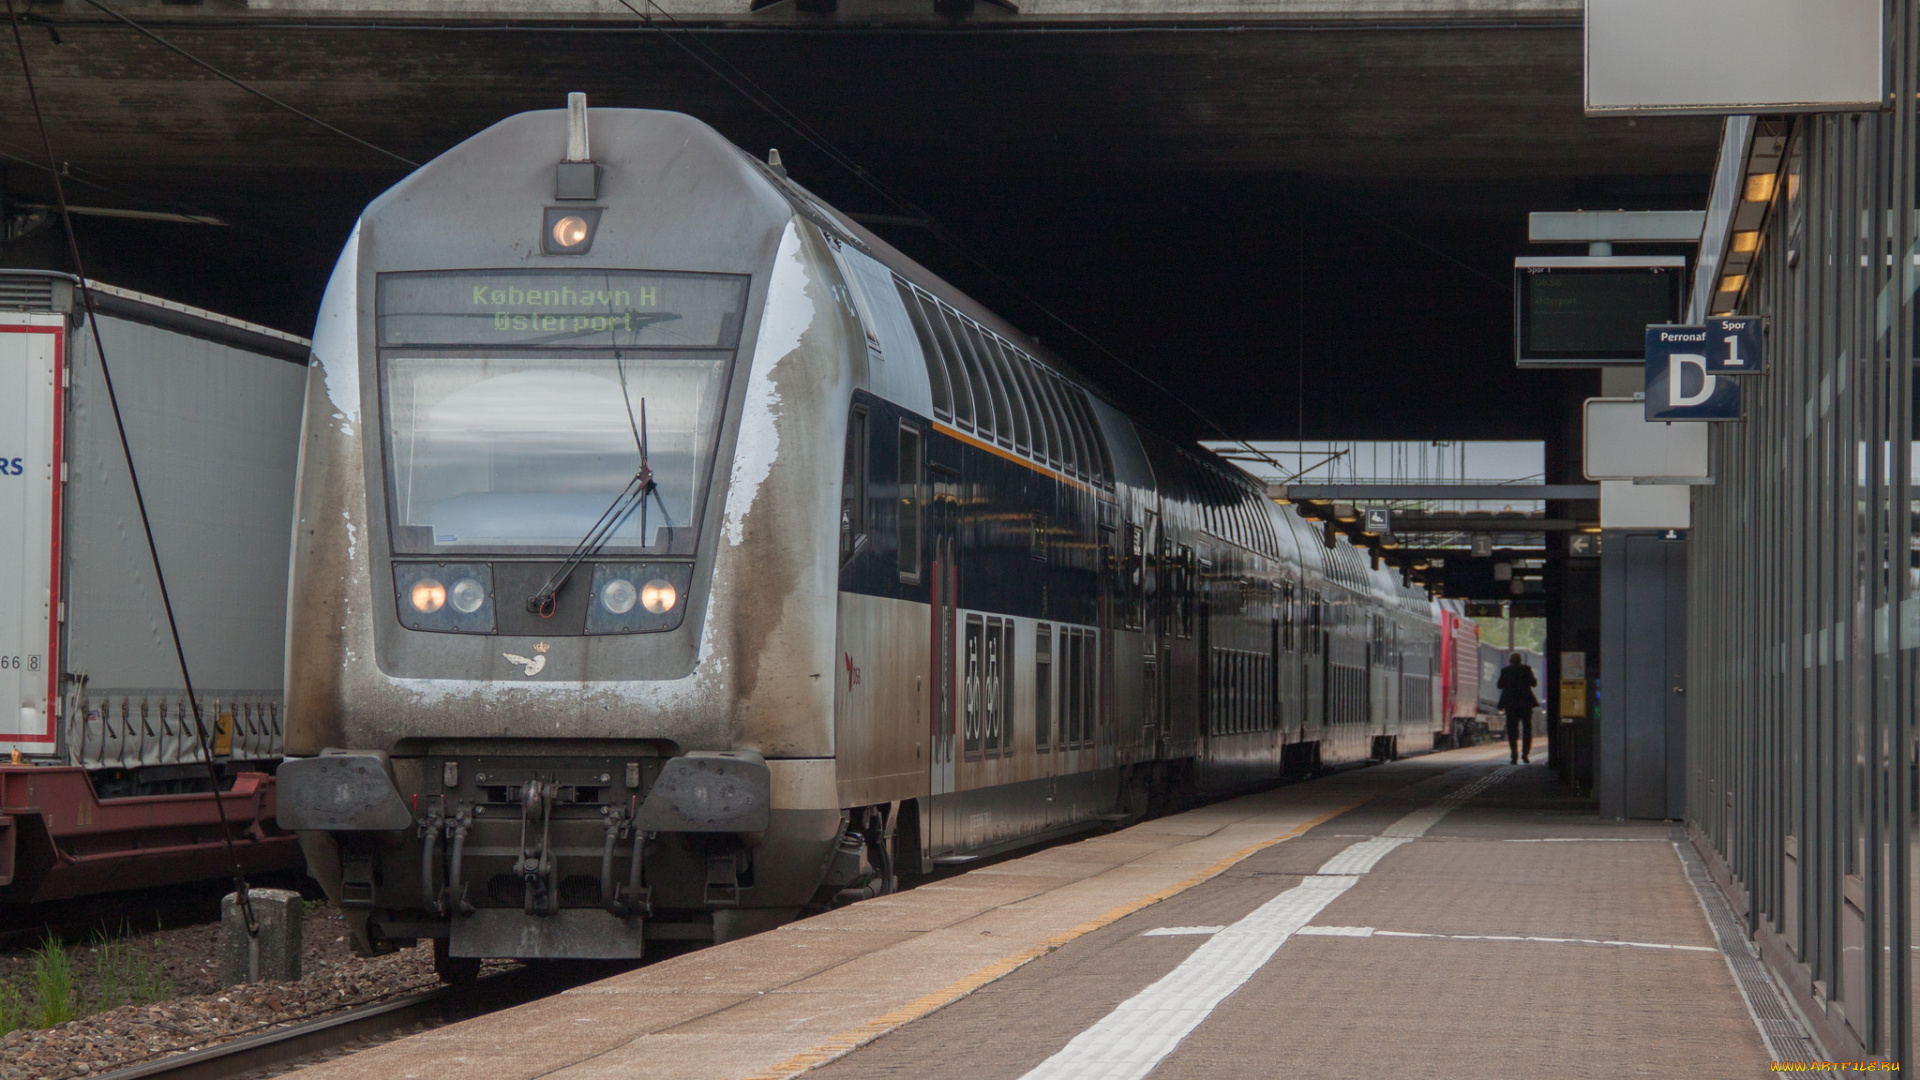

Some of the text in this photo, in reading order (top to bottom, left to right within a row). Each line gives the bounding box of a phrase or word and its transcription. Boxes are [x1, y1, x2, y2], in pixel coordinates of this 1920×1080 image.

[473, 285, 656, 306] København H
[494, 311, 632, 333] Østerport
[1722, 320, 1746, 331] Spor
[1723, 335, 1744, 366] 1
[1669, 353, 1717, 407] D
[1, 655, 38, 670] 66 8
